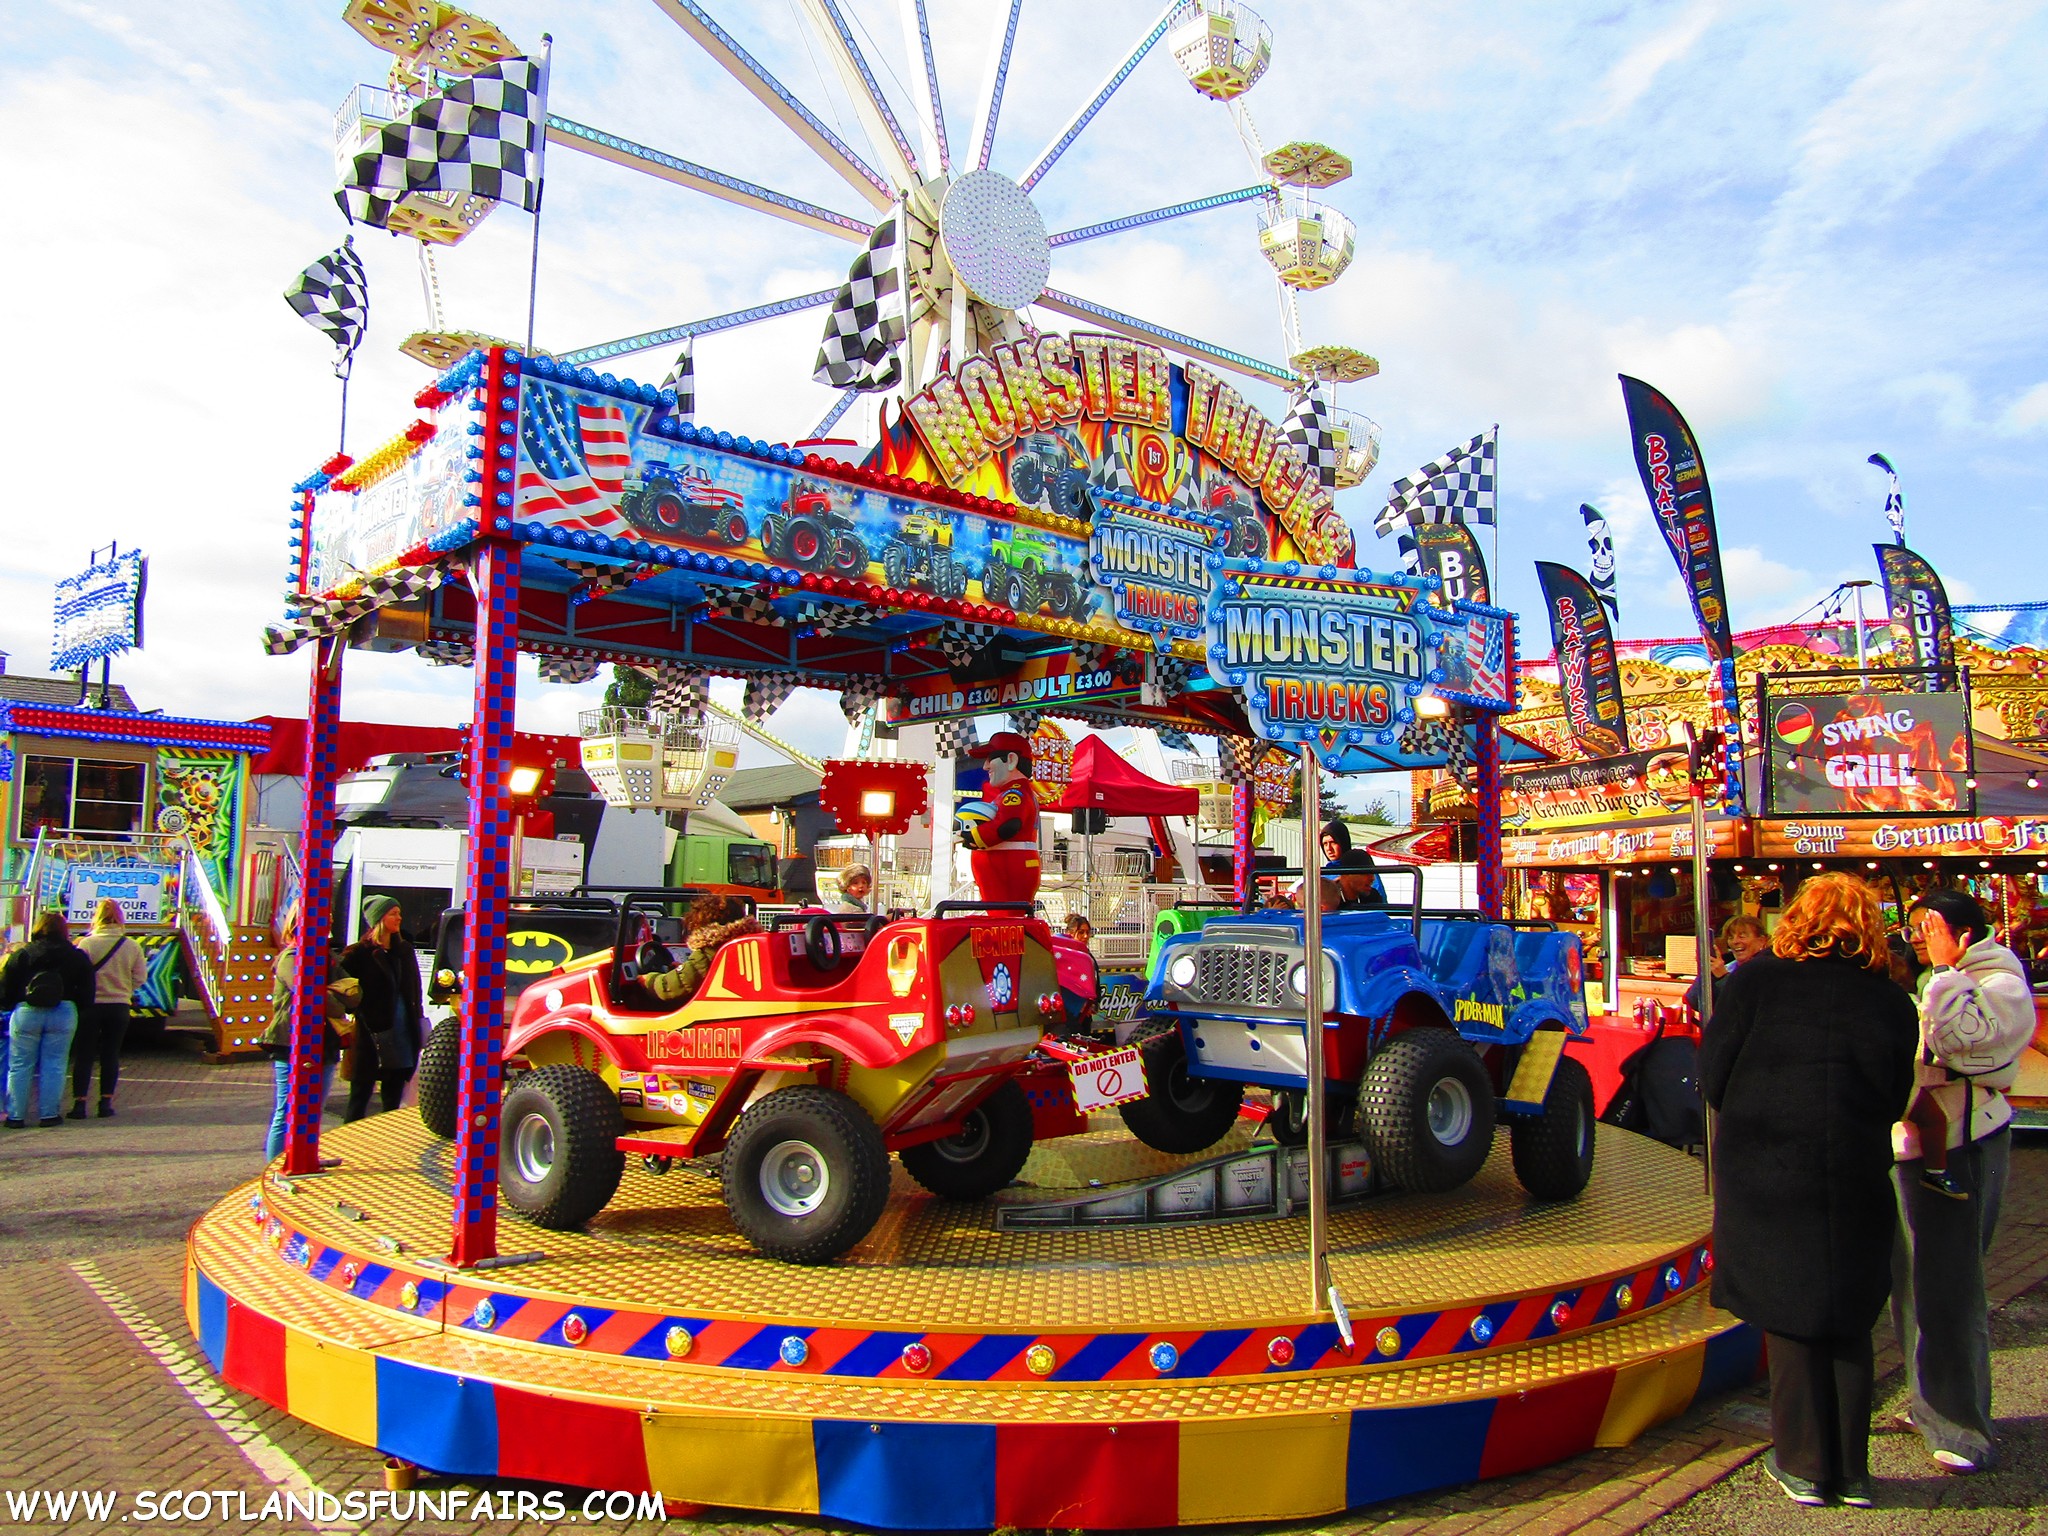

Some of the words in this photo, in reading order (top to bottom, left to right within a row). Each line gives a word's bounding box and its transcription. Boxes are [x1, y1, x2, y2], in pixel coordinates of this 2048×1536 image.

[903, 329, 1172, 489] MONSTER
[1184, 360, 1353, 569] TRUCKS
[1147, 446, 1161, 465] 1ST
[1124, 582, 1199, 625] TRUCKS
[1227, 607, 1420, 677] MONSTER
[1557, 597, 1590, 735] BRATWURST
[910, 691, 964, 716] CHILD
[967, 687, 998, 705] £3.00
[1001, 674, 1071, 704] ADULT
[1075, 669, 1112, 690] £3.00
[1264, 677, 1389, 726] TRUCKS
[1822, 709, 1915, 747] SWING
[1513, 773, 1568, 796] German
[1571, 763, 1636, 790] Sausage
[1825, 754, 1918, 788] GRILL
[1533, 799, 1593, 820] German
[1591, 791, 1659, 816] Burgers
[1548, 836, 1600, 861] German
[1608, 830, 1656, 861] Fayre
[1671, 827, 1714, 843] Gern
[1784, 822, 1846, 841] Swing
[1794, 839, 1837, 855] Grill
[1872, 822, 1985, 851] German
[1670, 843, 1716, 858] Sauge
[77, 871, 160, 887] TWISTER
[96, 885, 138, 899] RIDE
[126, 911, 158, 921] HERE
[970, 927, 1000, 958] IRON
[1000, 925, 1025, 955] MAN
[1100, 982, 1140, 1021] appy
[1454, 999, 1505, 1030] SPIDER-MAN
[647, 1028, 696, 1059] IRON
[697, 1027, 742, 1059] MAN
[1074, 1063, 1088, 1077] DO
[1089, 1058, 1108, 1073] NOT
[1109, 1050, 1137, 1067] ENTER
